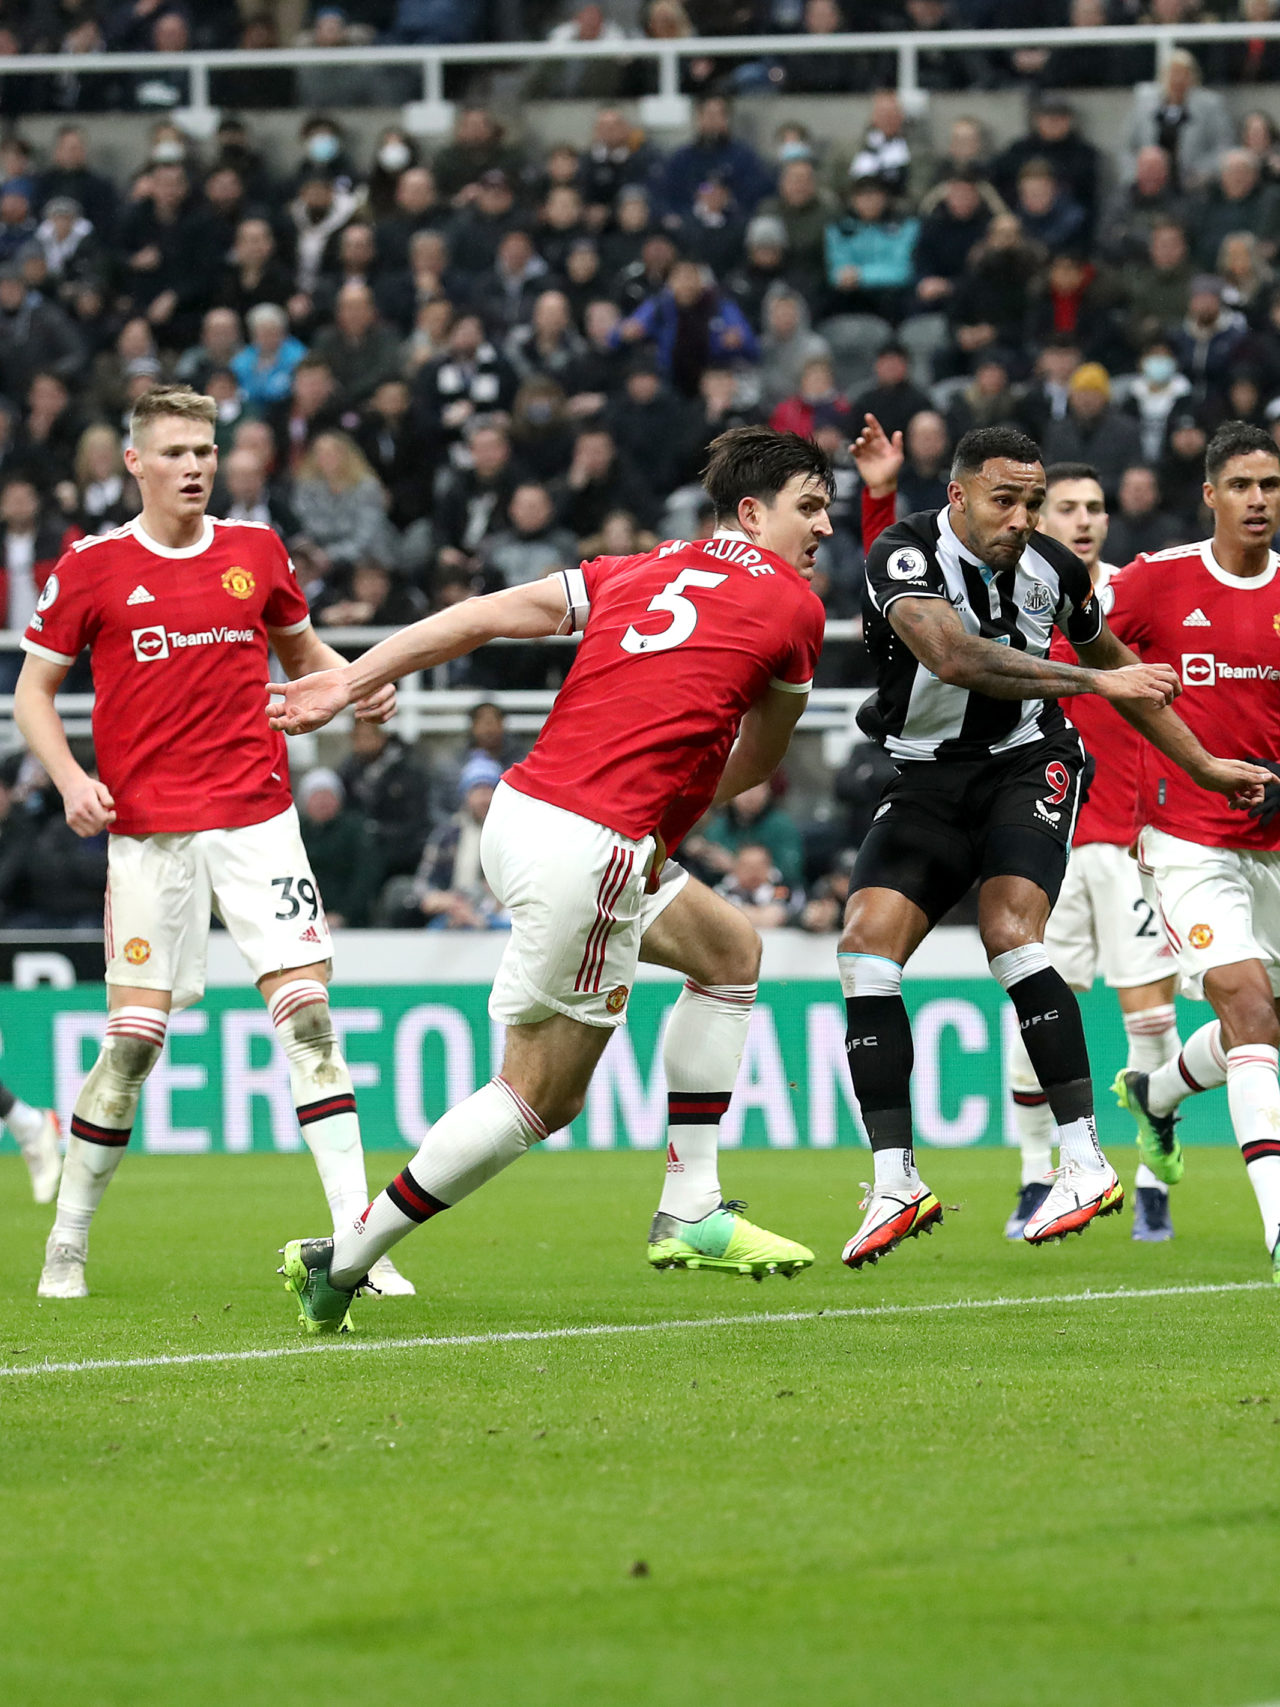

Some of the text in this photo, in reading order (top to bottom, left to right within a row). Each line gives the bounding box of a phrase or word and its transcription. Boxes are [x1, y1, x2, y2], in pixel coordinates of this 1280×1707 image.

[619, 568, 729, 654] 5
[167, 626, 255, 648] TeamViewer
[1043, 760, 1070, 805] 9
[271, 876, 318, 921] 39
[1133, 898, 1158, 937] 2
[53, 996, 1062, 1154] PEROMANC
